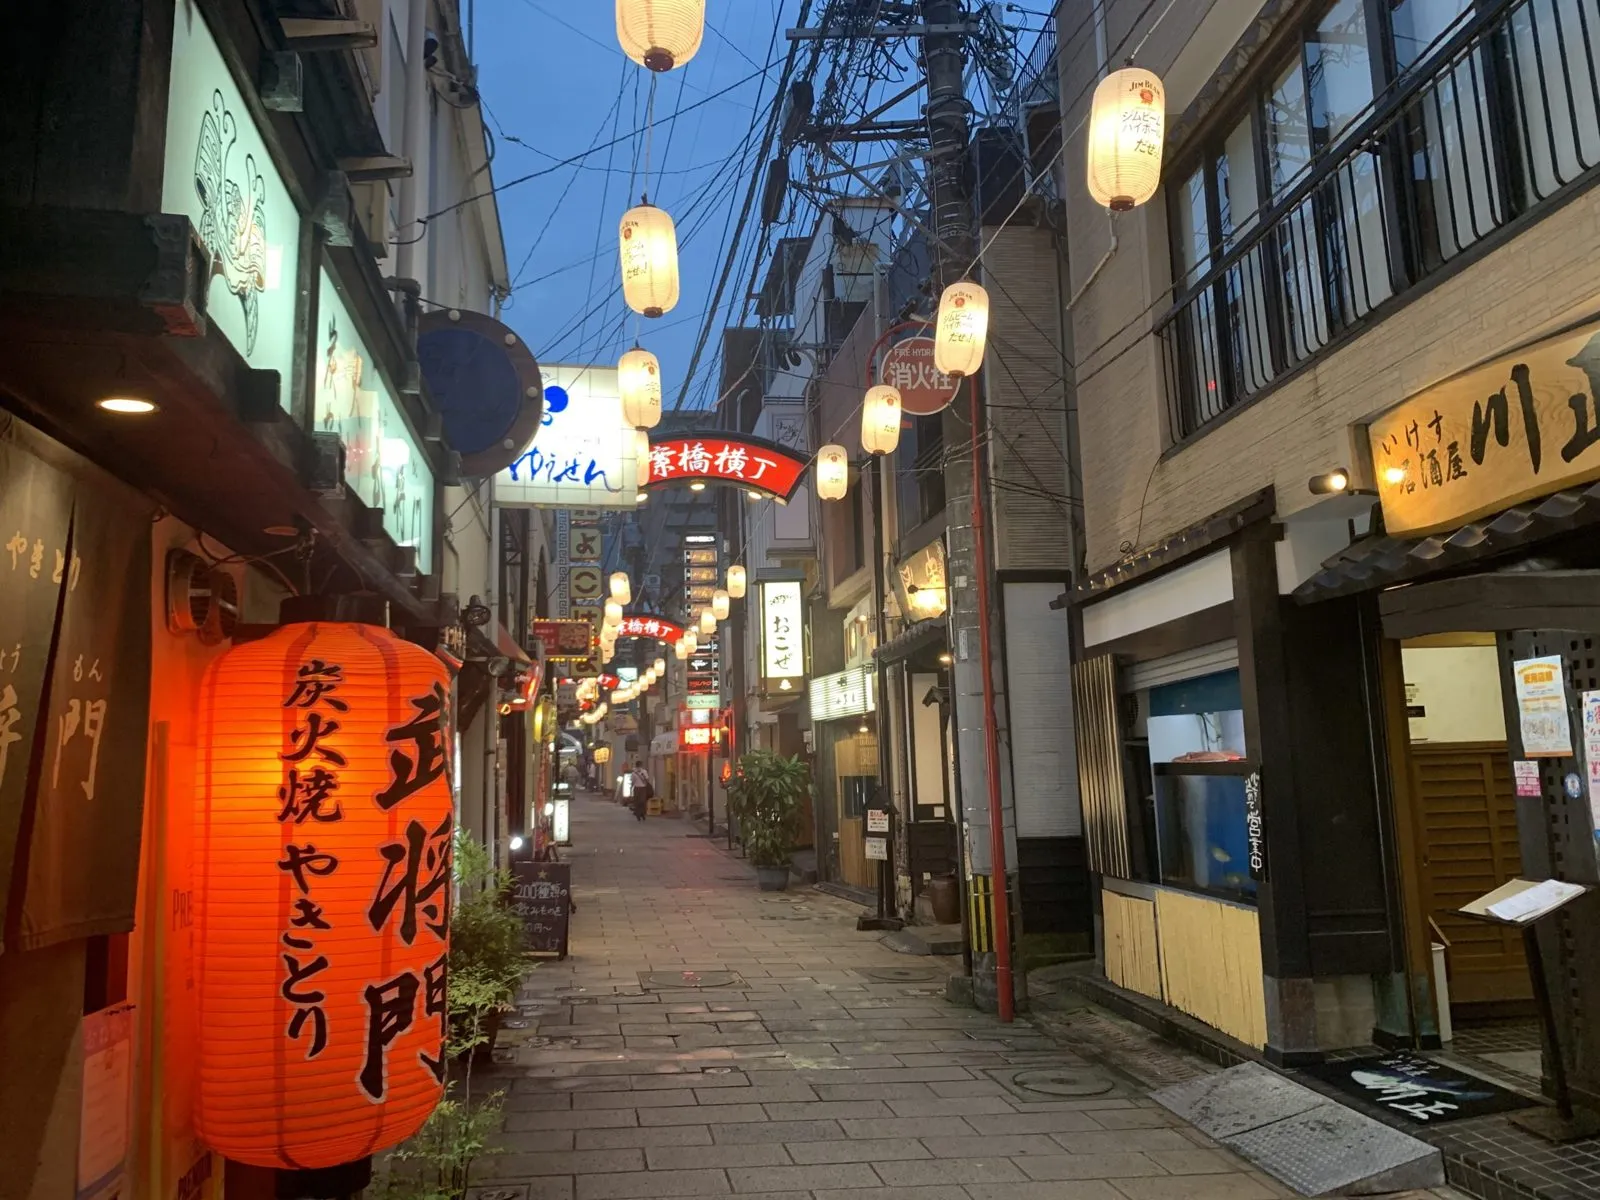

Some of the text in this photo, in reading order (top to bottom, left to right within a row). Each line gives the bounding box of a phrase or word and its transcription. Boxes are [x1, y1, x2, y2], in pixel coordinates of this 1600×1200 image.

[1129, 81, 1144, 92] JIM
[1382, 409, 1443, 455] いけす
[1399, 440, 1468, 495] 居酒屋
[6, 530, 81, 591] やきとり
[773, 615, 792, 670] おこぜ
